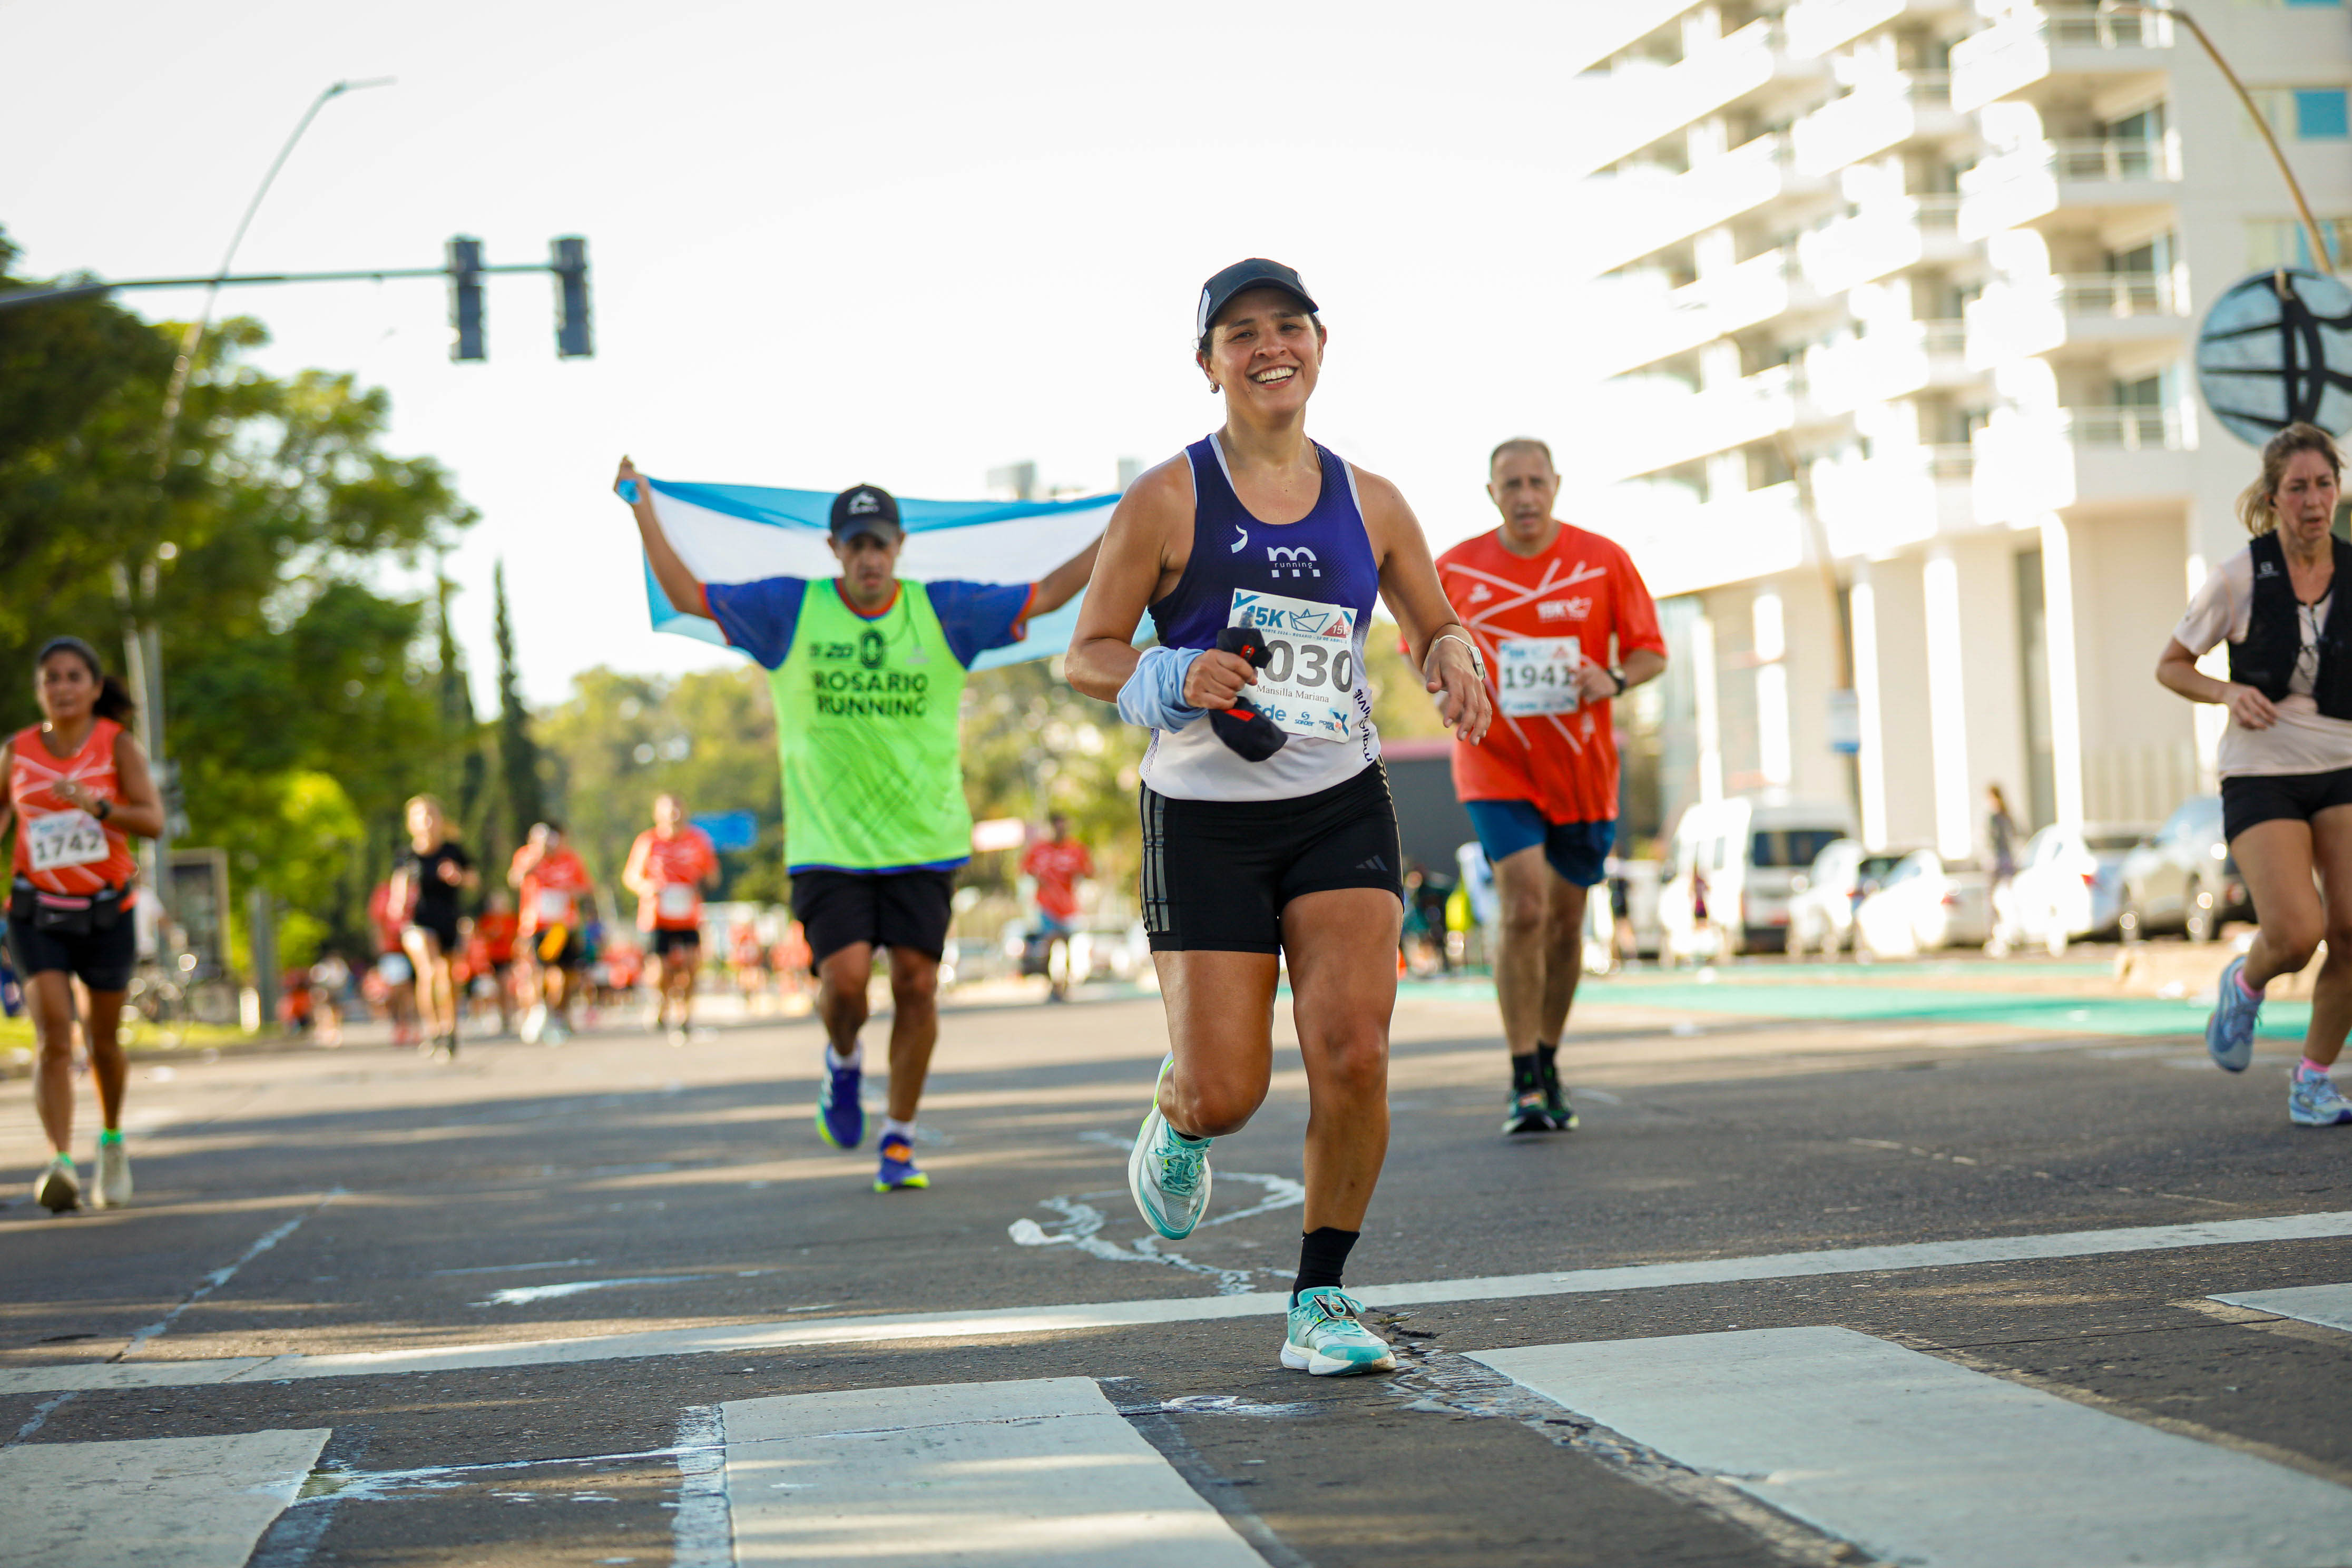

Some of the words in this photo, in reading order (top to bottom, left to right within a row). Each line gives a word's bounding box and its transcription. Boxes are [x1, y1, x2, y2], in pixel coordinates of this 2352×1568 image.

[1247, 605, 1286, 628] 15K
[1255, 640, 1353, 692] 030
[812, 671, 928, 693] ROSARIO
[1257, 685, 1292, 697] Mansilla
[1296, 691, 1329, 703] Mariana
[817, 695, 927, 717] RUNNING
